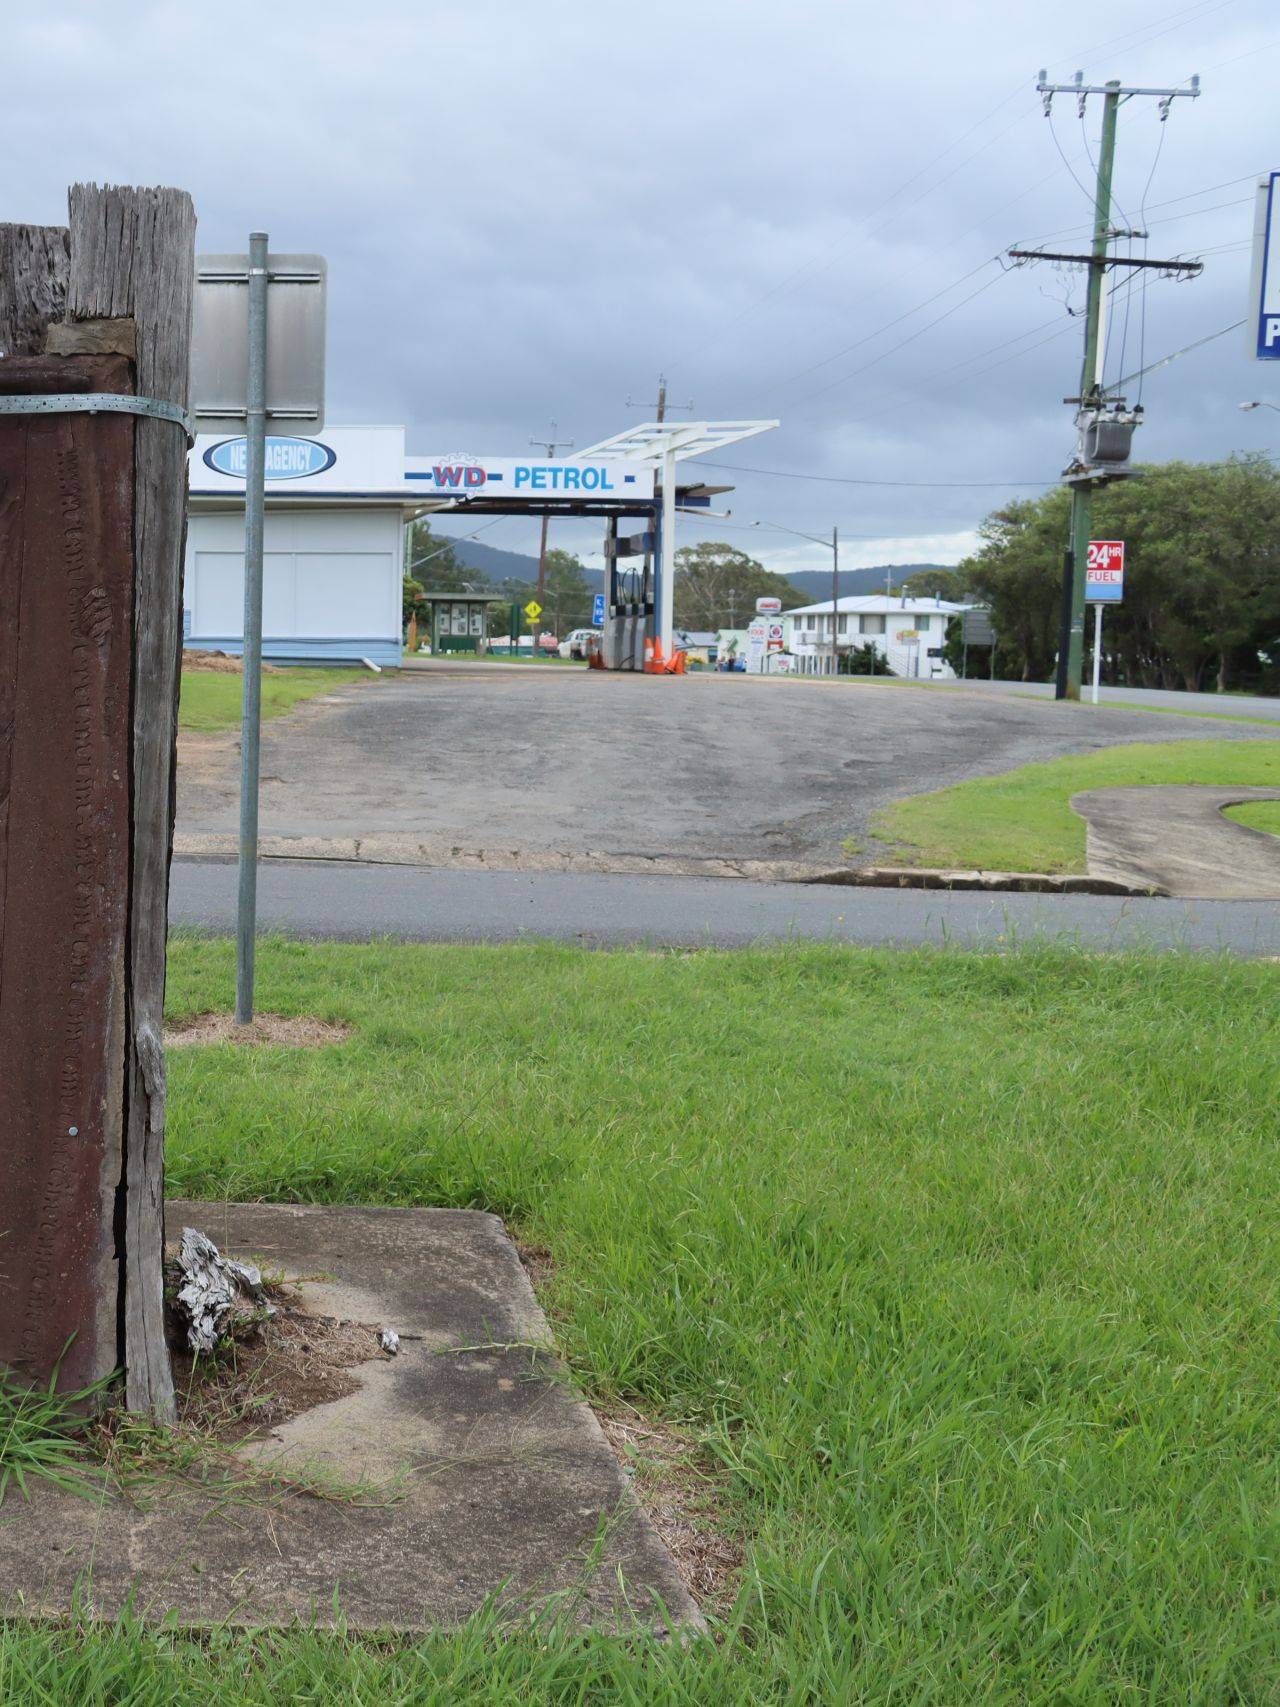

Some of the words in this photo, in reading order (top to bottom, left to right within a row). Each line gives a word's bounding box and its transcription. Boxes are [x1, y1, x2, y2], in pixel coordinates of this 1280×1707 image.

[230, 445, 312, 471] NEAGENCY
[432, 466, 487, 488] WD
[514, 466, 614, 490] PETROL
[1086, 544, 1110, 568] 24
[1109, 547, 1121, 557] HR
[1088, 572, 1116, 581] FUEL
